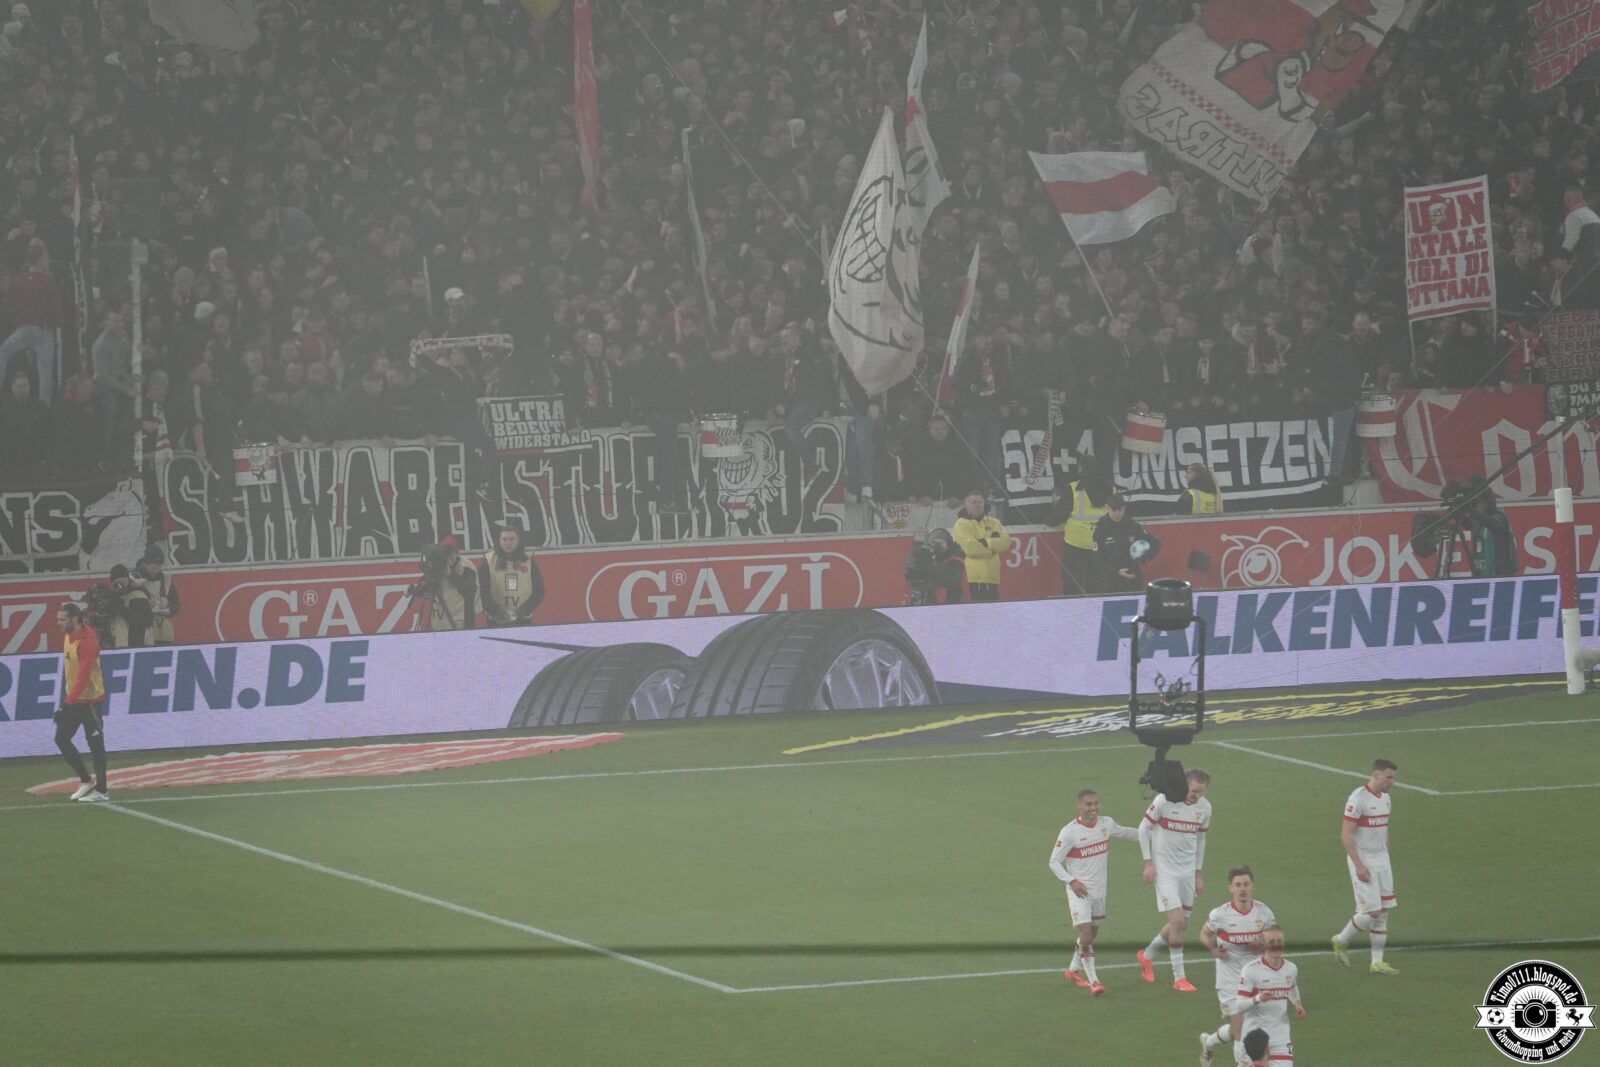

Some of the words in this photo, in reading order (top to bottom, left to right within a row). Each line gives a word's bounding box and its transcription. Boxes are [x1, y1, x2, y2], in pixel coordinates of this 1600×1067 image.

[1465, 251, 1490, 276] DI
[490, 399, 565, 422] ULTRA
[1006, 536, 1040, 569] 34
[1097, 577, 1600, 661] FALKENREIFE
[0, 640, 369, 722] EFEN.DE
